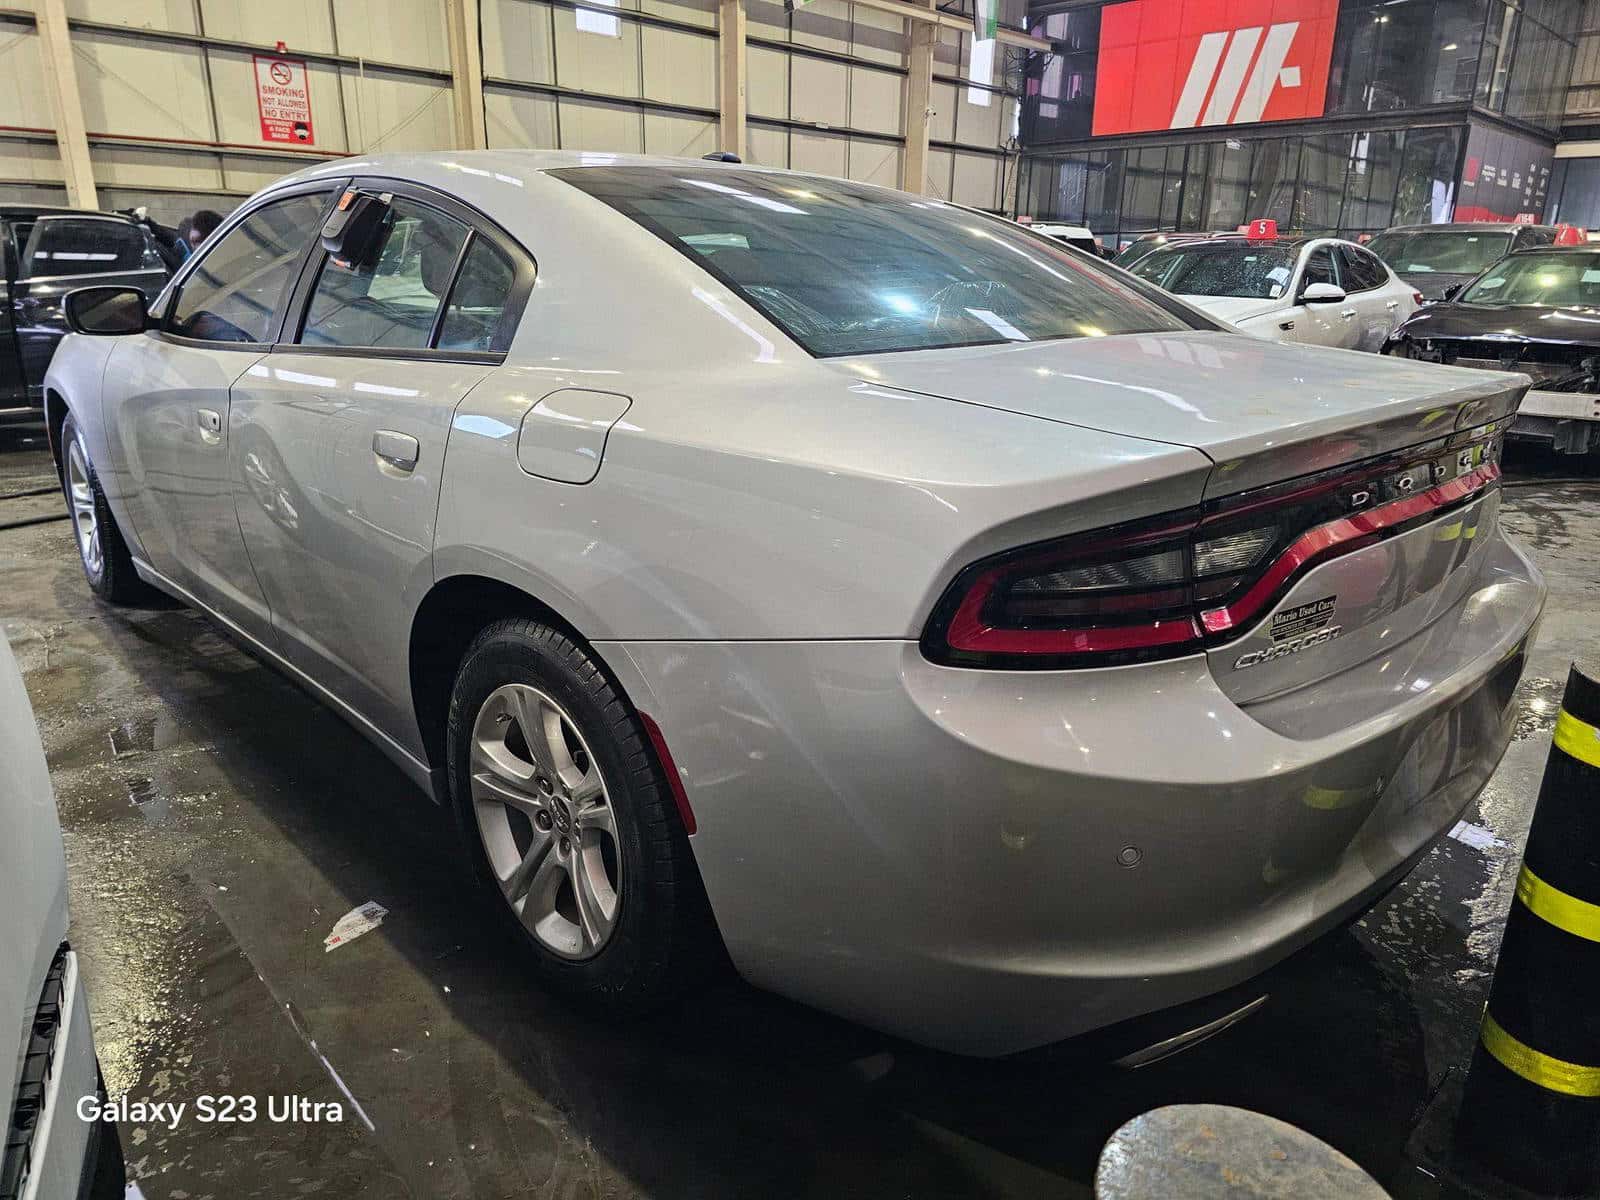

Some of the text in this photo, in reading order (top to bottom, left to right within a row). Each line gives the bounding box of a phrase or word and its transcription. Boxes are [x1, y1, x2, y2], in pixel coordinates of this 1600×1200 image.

[263, 85, 305, 98] SMOKING
[263, 97, 306, 109] NOT ALLOWED
[265, 109, 306, 120] NO ENTRY
[1259, 222, 1266, 234] 5
[1299, 604, 1317, 617] Used
[1232, 624, 1343, 671] CHARGER
